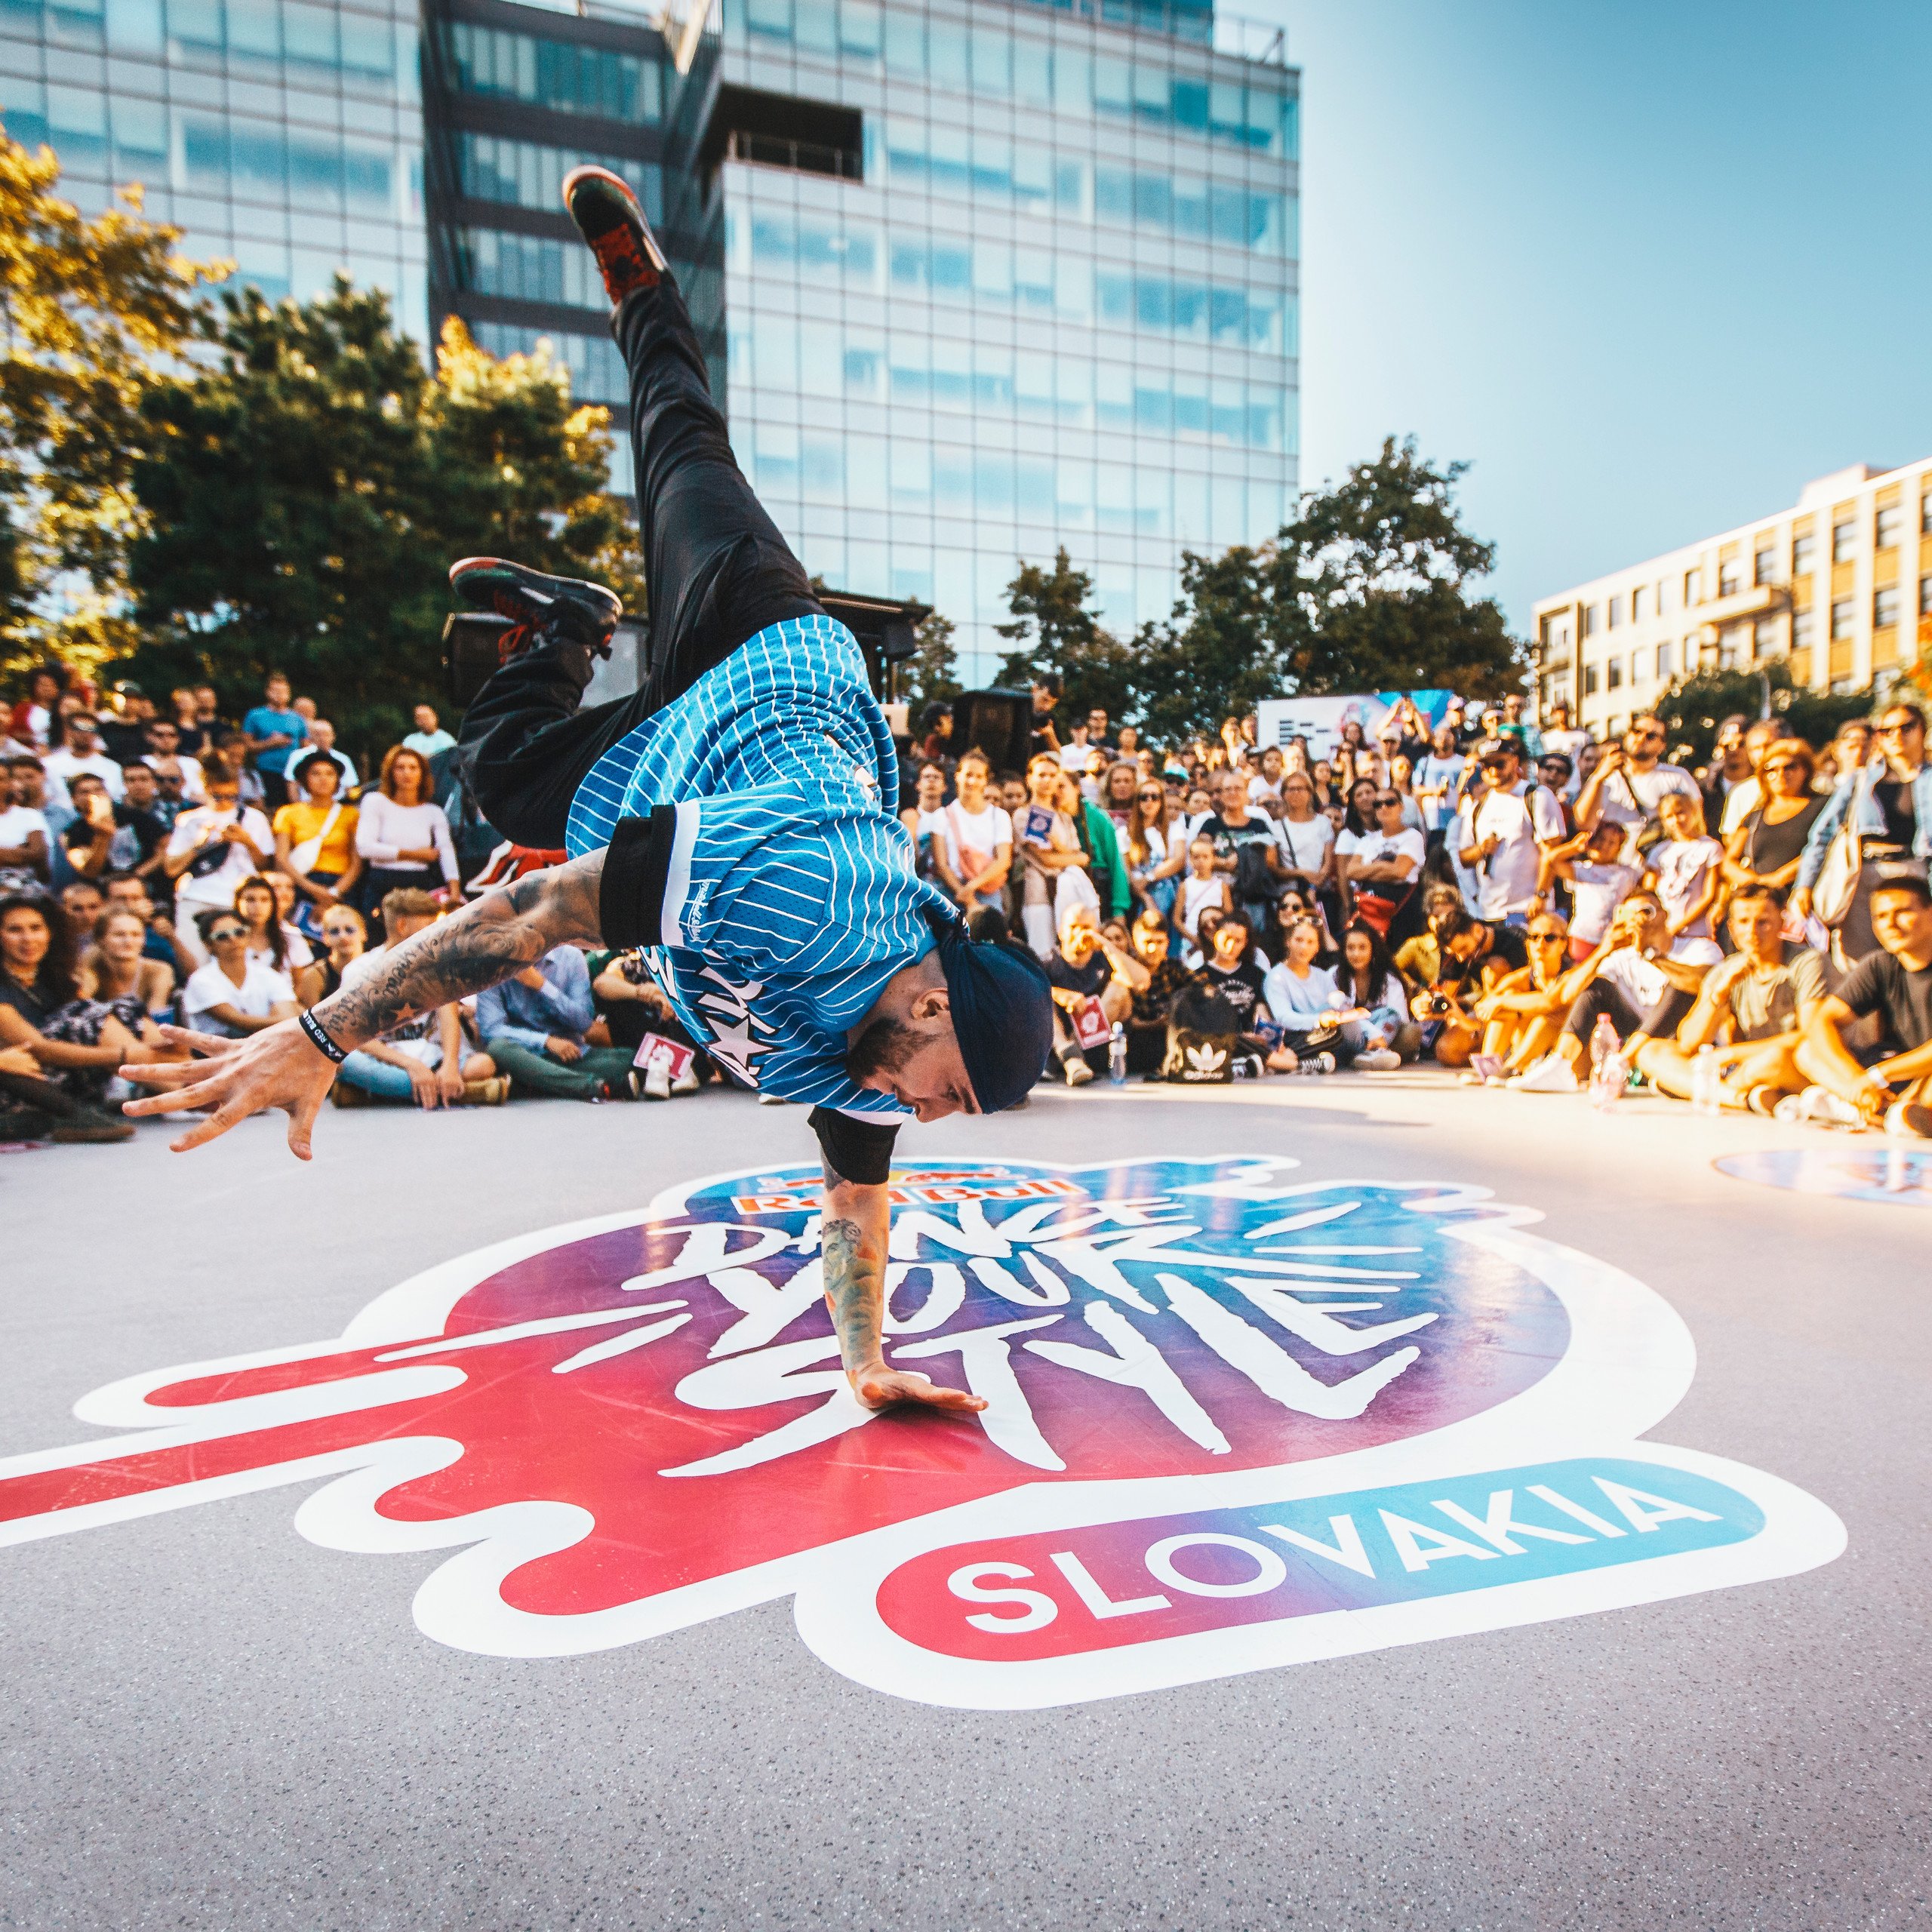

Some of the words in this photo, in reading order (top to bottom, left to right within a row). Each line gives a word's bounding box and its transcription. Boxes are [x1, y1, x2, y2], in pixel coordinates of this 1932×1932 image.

[314, 1029, 327, 1043] RED
[920, 1180, 1082, 1201] Bull
[658, 1273, 1440, 1478] STYLE
[947, 1475, 1724, 1634] SLOVAKIA
